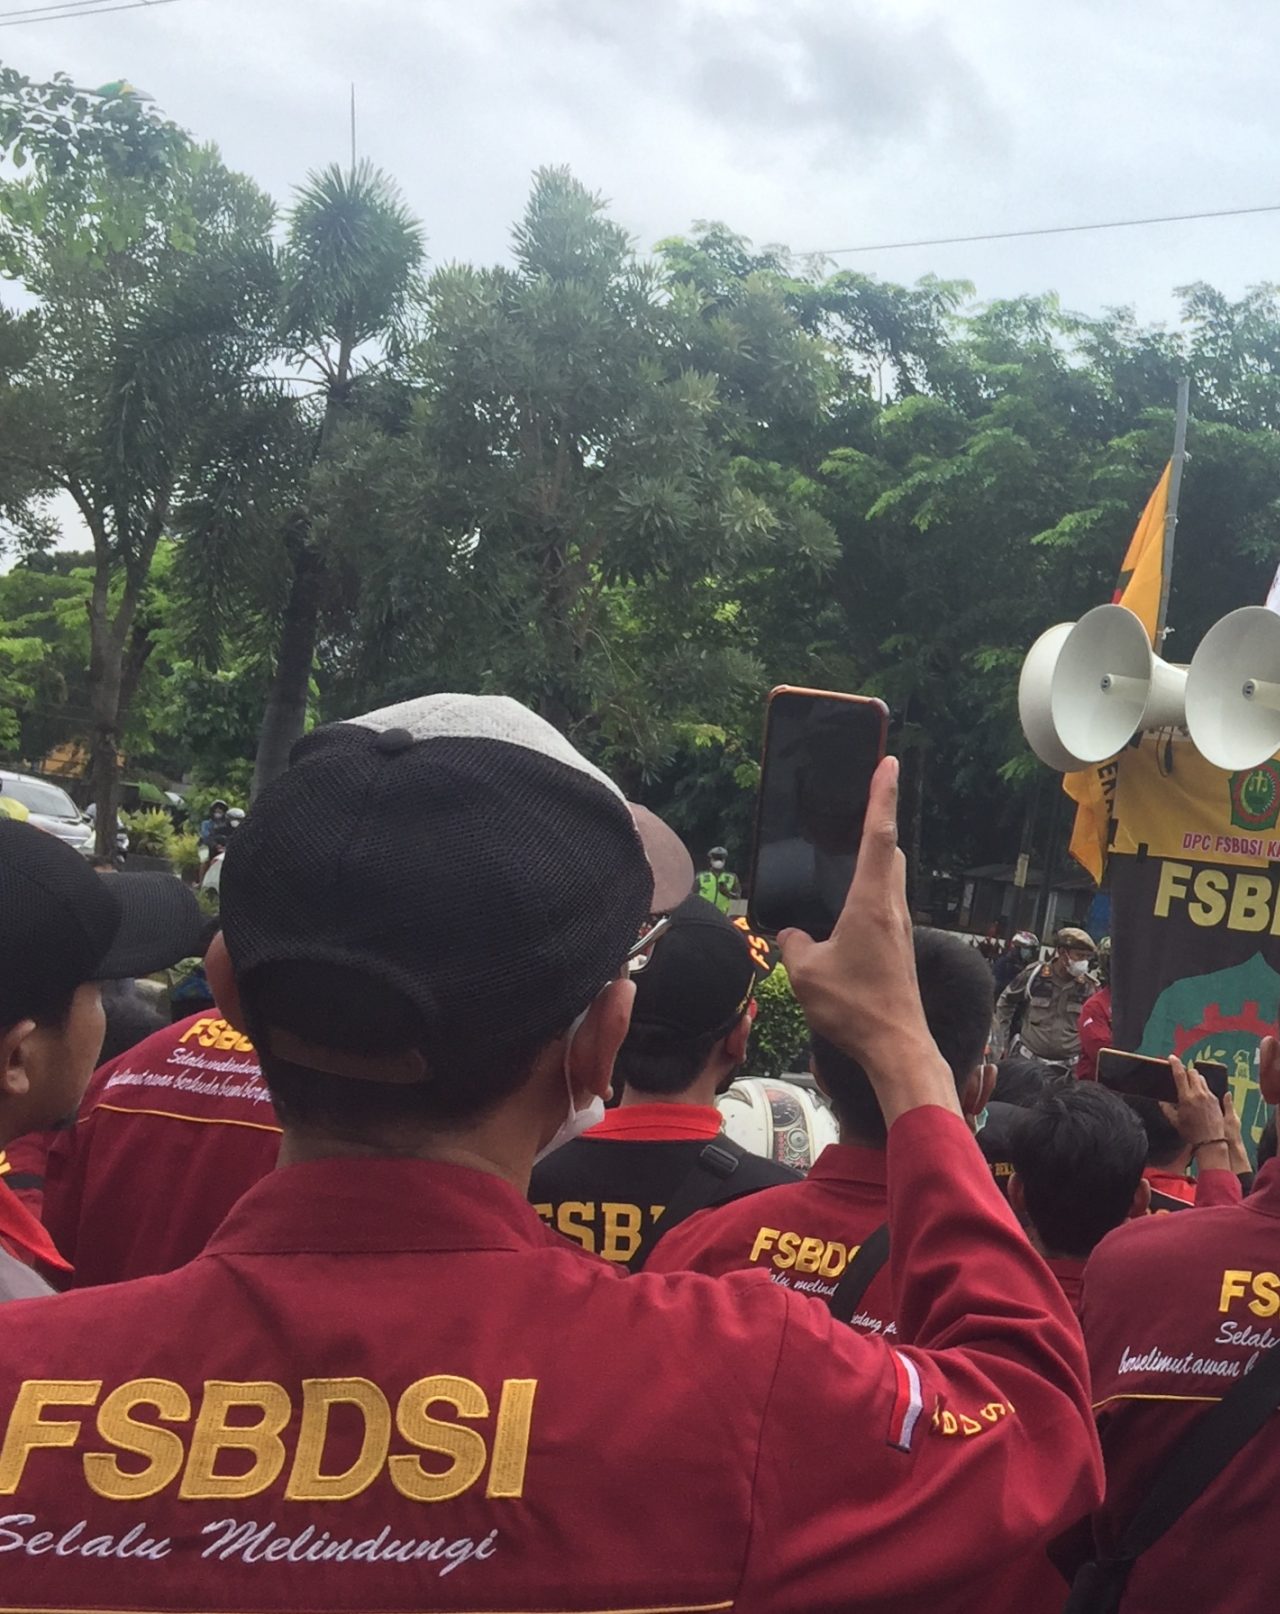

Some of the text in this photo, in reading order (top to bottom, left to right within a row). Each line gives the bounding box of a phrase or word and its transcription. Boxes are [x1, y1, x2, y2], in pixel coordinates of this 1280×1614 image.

[1182, 833, 1212, 852] DPC
[1215, 836, 1263, 857] FSBDSI
[749, 1226, 862, 1278] FSBD
[1191, 1356, 1240, 1377] awan
[0, 1374, 538, 1501] FSBDSI
[0, 1513, 498, 1578] Selalu Melindungi
